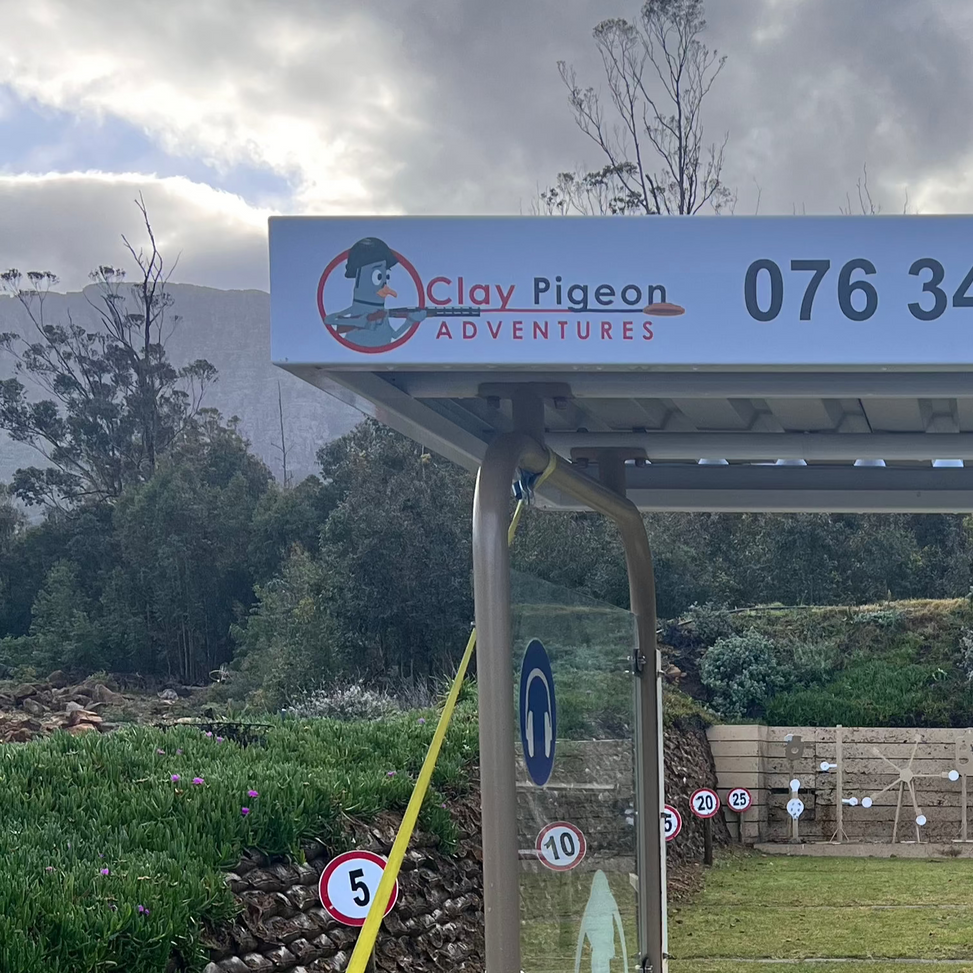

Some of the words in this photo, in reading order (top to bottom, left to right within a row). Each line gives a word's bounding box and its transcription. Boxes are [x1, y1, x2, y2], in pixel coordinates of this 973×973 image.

[426, 276, 516, 311] Clay
[533, 276, 667, 312] Pigeon
[743, 258, 878, 322] 076
[435, 320, 655, 340] ADVENTURES
[696, 795, 713, 811] 20
[732, 793, 747, 806] 25
[544, 832, 576, 861] 10
[348, 868, 371, 907] 5
